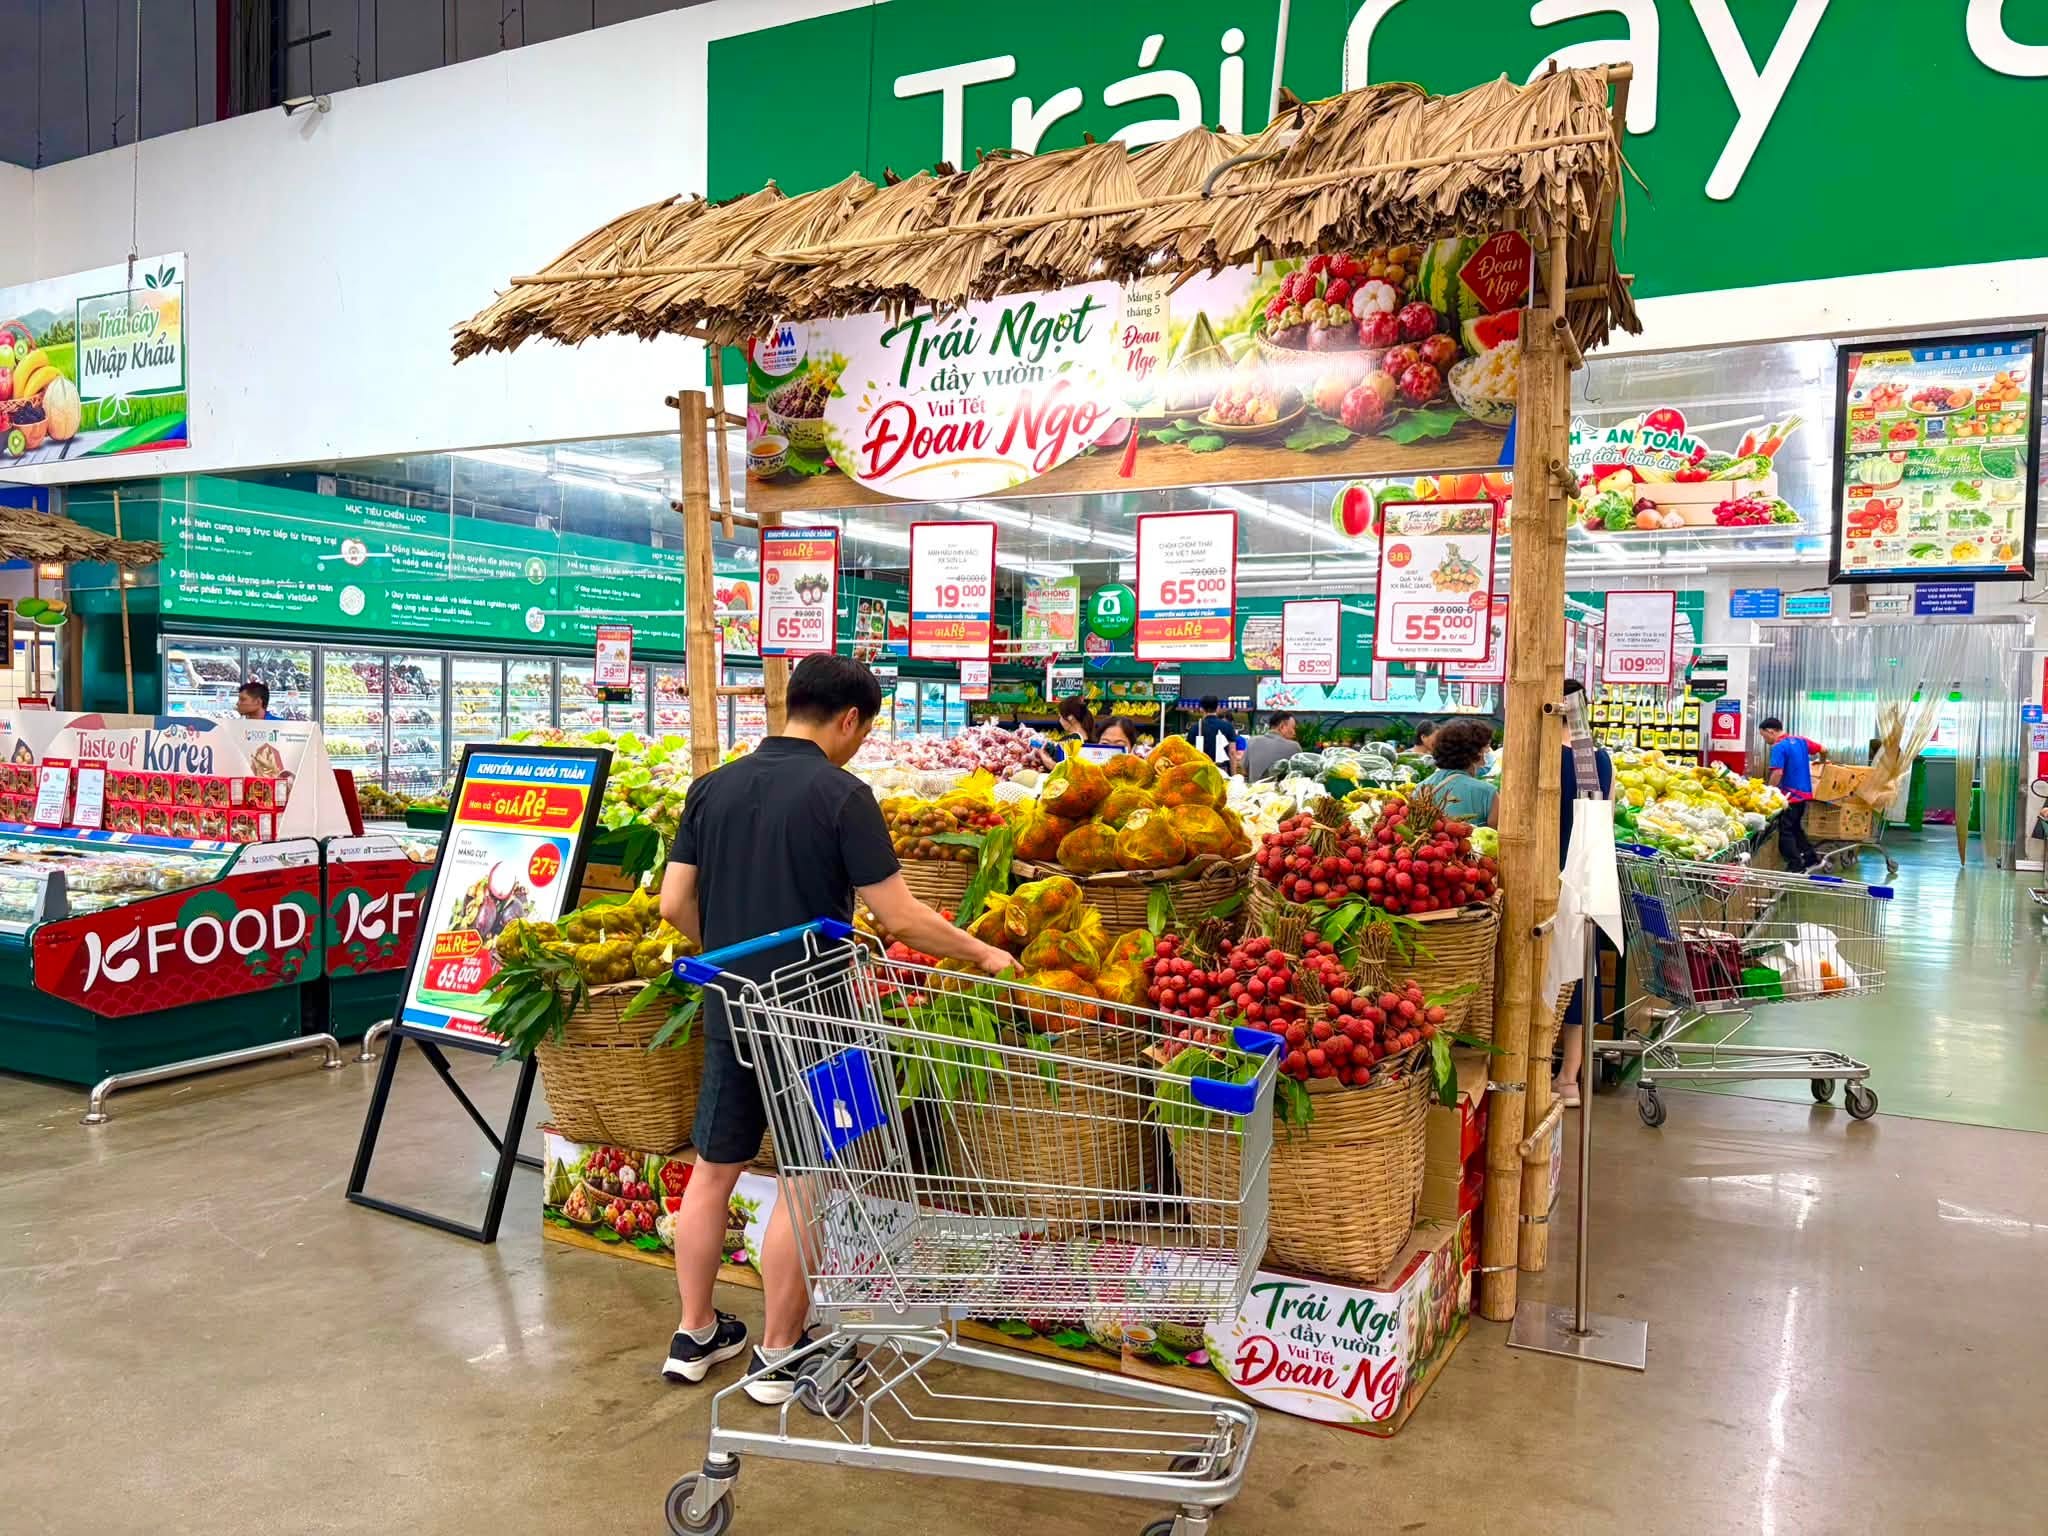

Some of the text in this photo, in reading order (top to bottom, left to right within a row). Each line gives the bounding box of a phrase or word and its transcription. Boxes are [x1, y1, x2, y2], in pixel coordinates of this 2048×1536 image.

[893, 27, 1246, 173] Trái
[1492, 233, 1516, 254] Tết
[1476, 258, 1525, 280] Đoan
[1154, 289, 1162, 300] 5
[1485, 276, 1521, 303] Ngọ
[98, 305, 160, 339] Trái cây
[1126, 303, 1161, 318] tháng 5
[880, 292, 1109, 389] Trái Ngọt
[1121, 324, 1161, 351] Đoan
[85, 331, 176, 379] Nhập Khẩu
[1126, 347, 1159, 382] Ngọ
[929, 359, 1046, 397] đầy vườn
[927, 395, 987, 418] Vui Tết
[857, 379, 1110, 481] Đoan Ngọ
[1605, 428, 1635, 445] AN
[1641, 430, 1697, 454] TOÀN
[1592, 445, 1621, 461] đến
[1625, 447, 1656, 467] bàn
[345, 504, 362, 515] MỤC
[76, 730, 214, 775] Taste of Korea
[476, 761, 513, 775] KHUYẾN
[534, 763, 558, 778] CUỐI
[558, 764, 587, 780] TUẦN
[494, 789, 549, 819] GIÁ Rẻ
[1250, 1281, 1332, 1330] Trái
[1287, 1343, 1336, 1366] Vui Tết
[1289, 1323, 1381, 1358] đầy vườn
[1230, 1333, 1402, 1421] Đoan Ng
